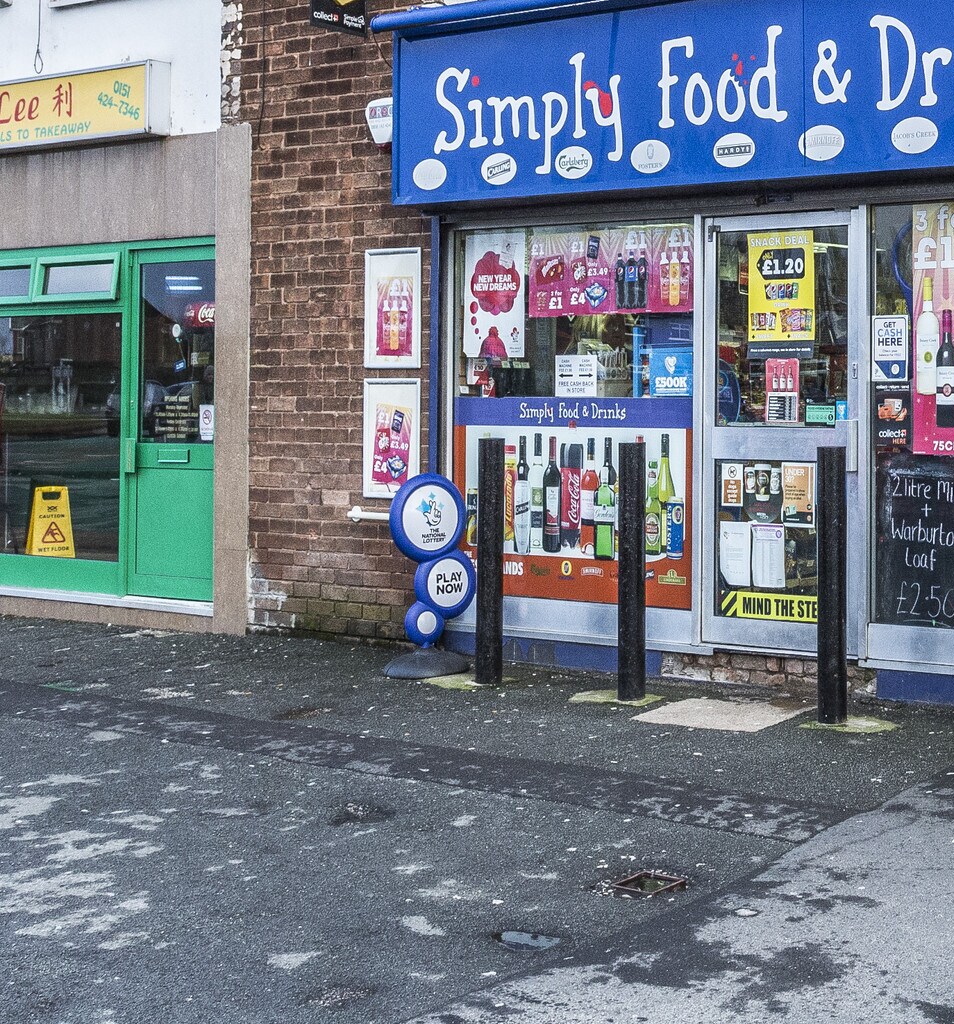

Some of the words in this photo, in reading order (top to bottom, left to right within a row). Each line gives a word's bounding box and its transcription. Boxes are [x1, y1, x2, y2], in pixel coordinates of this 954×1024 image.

[113, 79, 131, 99] 0151
[52, 81, 73, 118] 利
[434, 52, 623, 175] Simply
[658, 25, 788, 129] Food
[812, 39, 852, 105] &
[97, 91, 141, 122] 424-7346
[17, 127, 30, 140] TO
[35, 121, 92, 139] TAKEAWAY
[718, 145, 752, 156] HARDYS
[558, 154, 590, 169] Carlsberg
[915, 209, 928, 232] 3
[625, 230, 648, 250] £1
[668, 228, 691, 248] £1
[750, 237, 782, 247] SNACK
[784, 235, 809, 245] DEAL
[530, 243, 545, 256] £1
[570, 241, 584, 253] £1
[587, 267, 608, 276] £3.49
[762, 258, 804, 275] £1.20
[478, 274, 494, 283] NEW
[494, 274, 512, 283] YEAR
[390, 278, 409, 296] £1
[473, 283, 489, 292] NEW
[489, 282, 517, 292] DREAMS
[548, 297, 563, 310] £1
[570, 293, 586, 306] £4
[883, 321, 897, 329] GET
[877, 328, 903, 338] CASH
[877, 337, 903, 347] HERE
[655, 376, 687, 388] £500K
[378, 411, 390, 424] £1
[519, 402, 554, 423] Simply
[558, 402, 580, 419] Food
[582, 406, 589, 418] &
[591, 403, 627, 420] Drinks
[390, 440, 409, 451] £3.49
[373, 461, 388, 474] £4
[785, 468, 805, 476] UNDER
[892, 477, 902, 496] 2
[904, 480, 931, 499] litre
[505, 473, 513, 522] Lucozade
[921, 504, 932, 517] +
[421, 532, 446, 540] NATIONAL
[436, 571, 462, 585] PLAY
[436, 581, 463, 596] NOW
[742, 596, 771, 617] MIND
[774, 598, 794, 618] THE
[797, 600, 818, 620] STE
